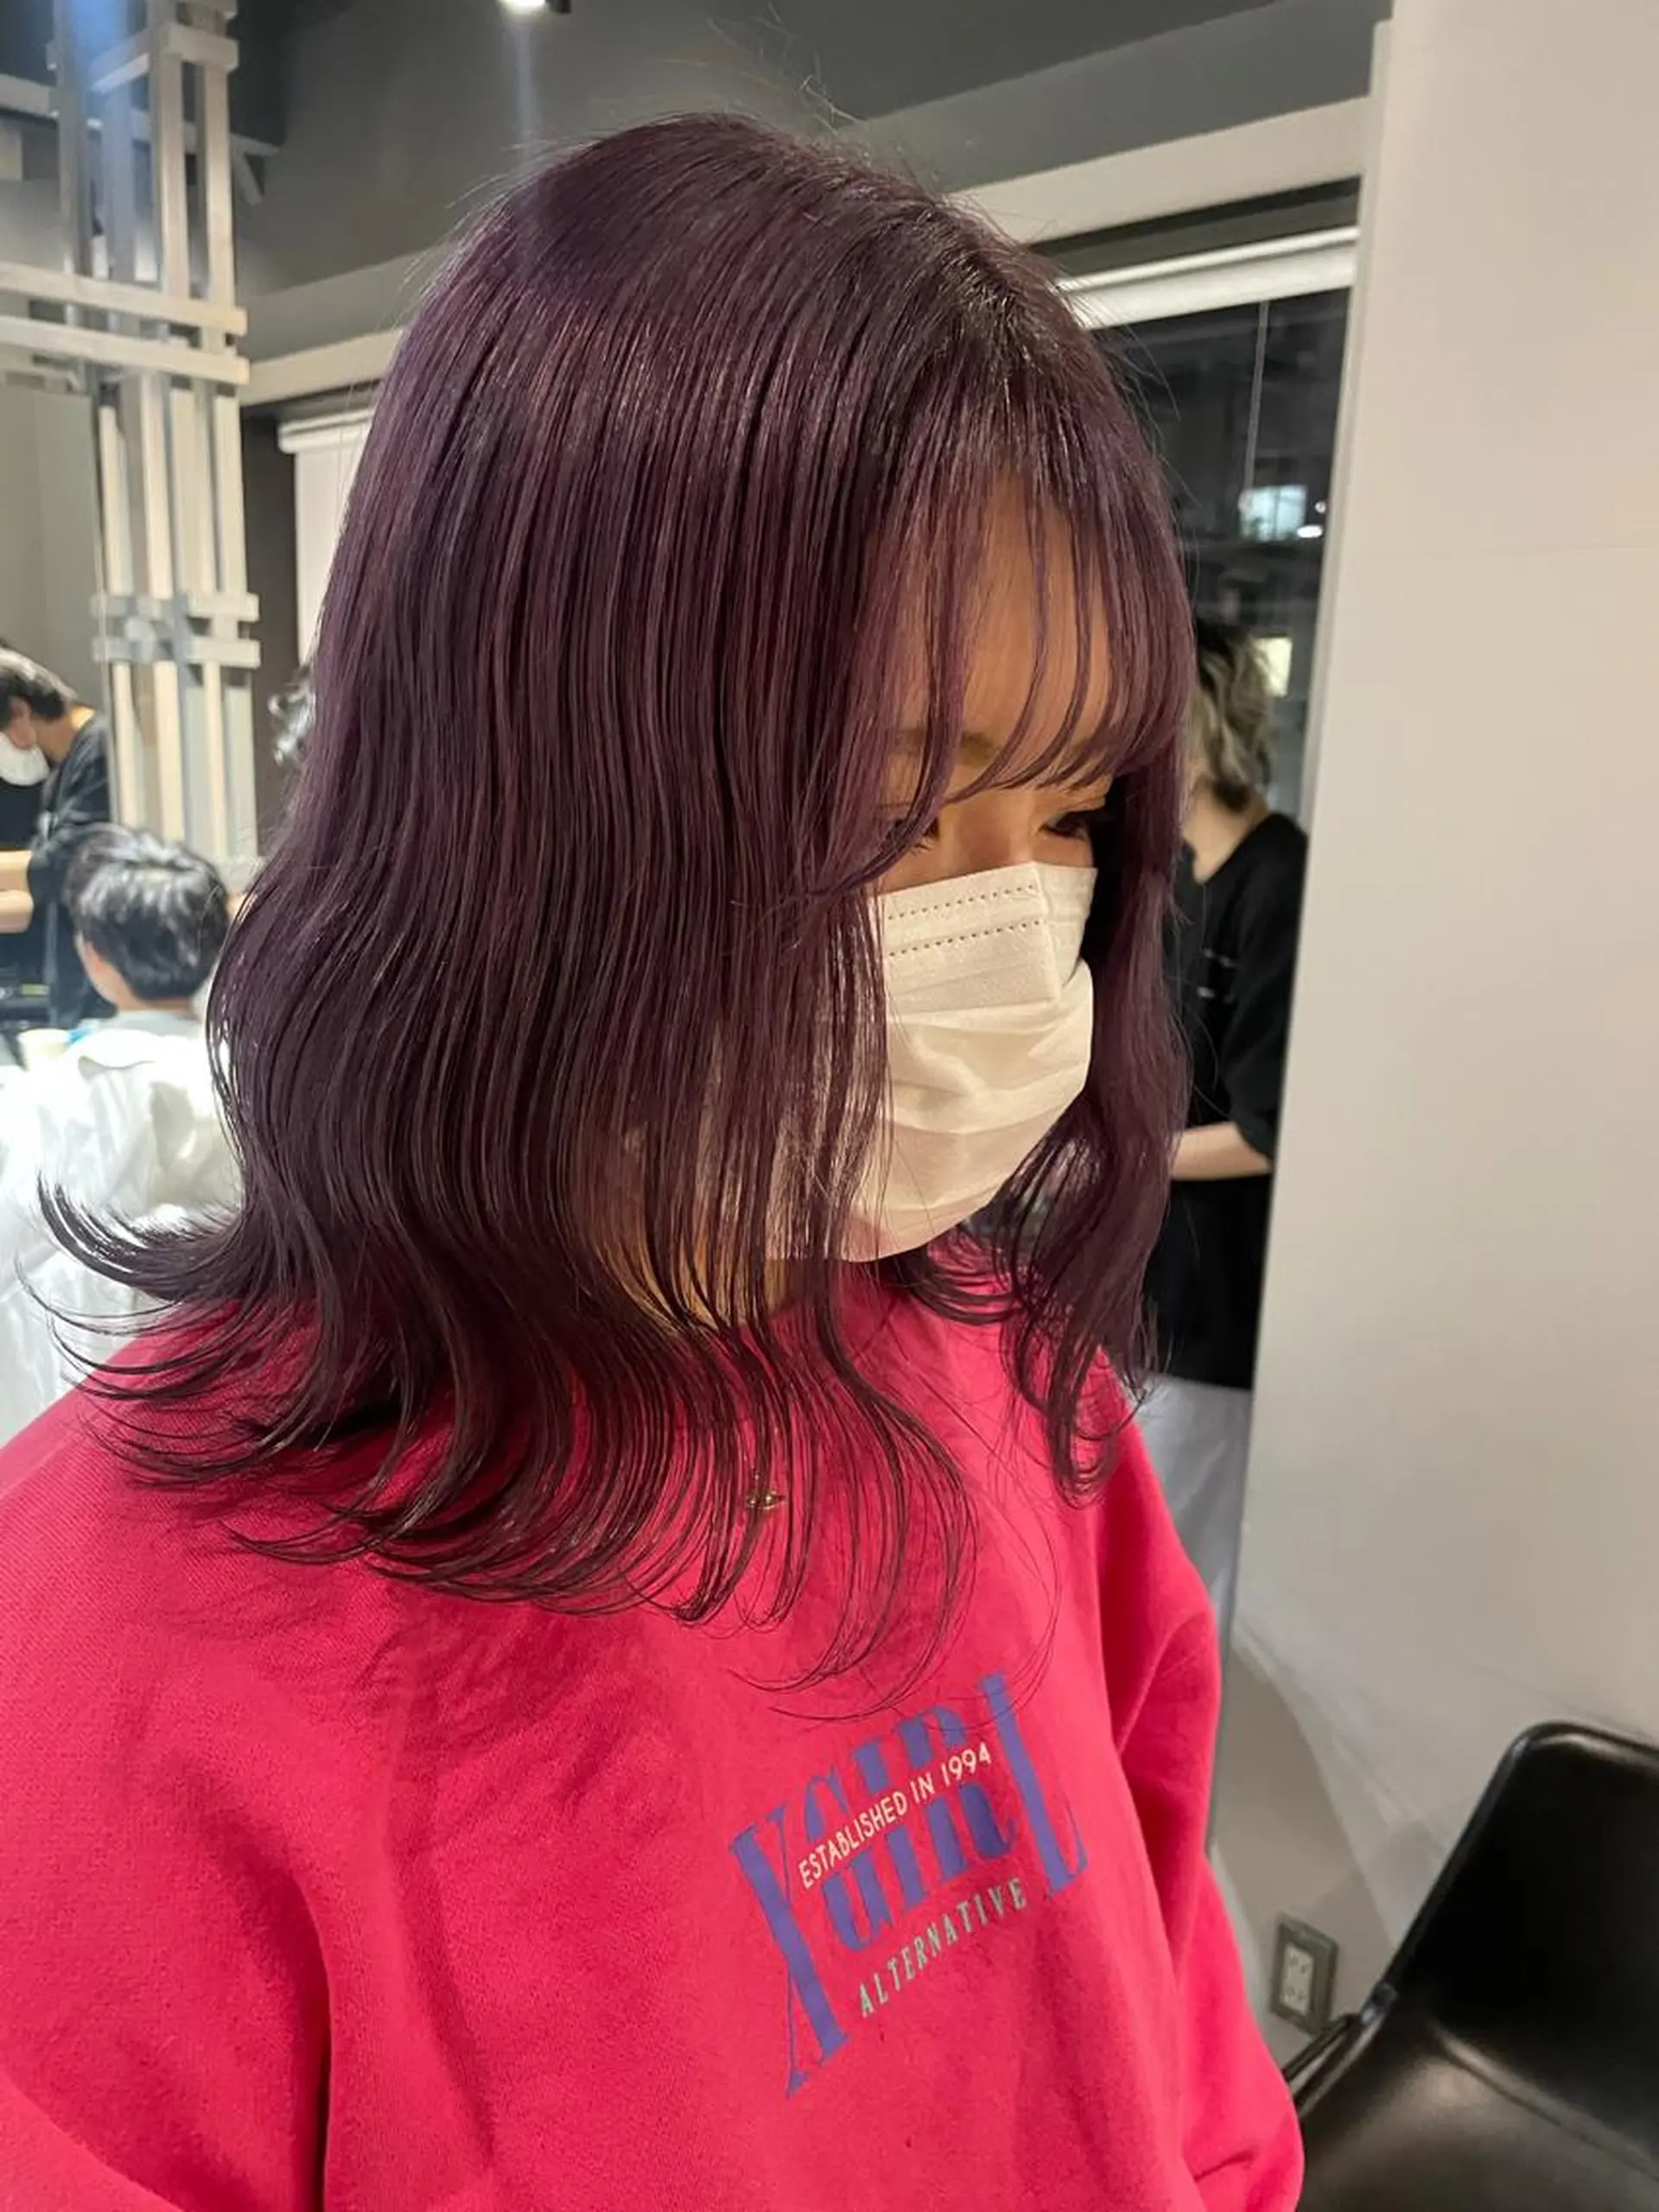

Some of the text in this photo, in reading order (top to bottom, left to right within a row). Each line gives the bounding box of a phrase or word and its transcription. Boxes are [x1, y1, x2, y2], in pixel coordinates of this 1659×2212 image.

[798, 1741, 992, 1890] ESTABLISHED IN 1994
[858, 1877, 1027, 2018] ALTERNATIVE
